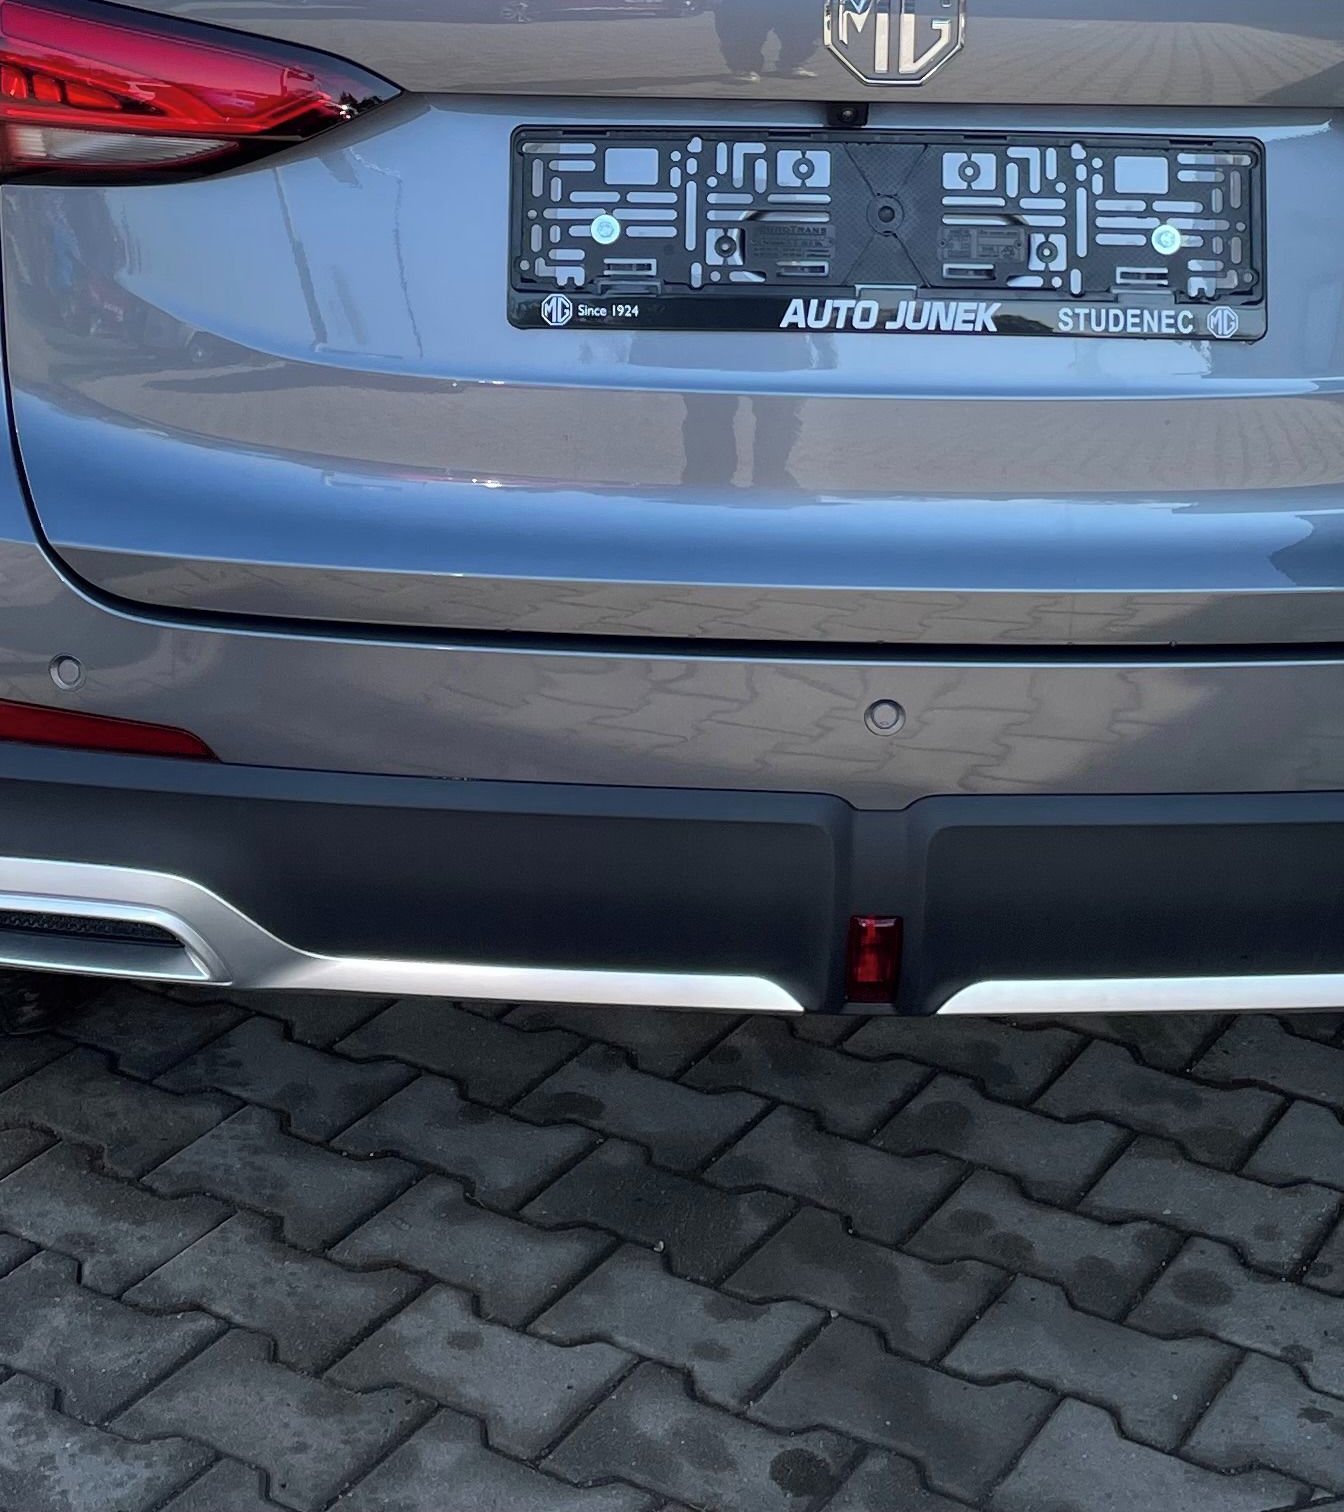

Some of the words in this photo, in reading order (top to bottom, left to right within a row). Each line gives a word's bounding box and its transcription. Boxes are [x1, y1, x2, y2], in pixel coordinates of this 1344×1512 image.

[544, 296, 570, 323] MG
[577, 303, 608, 317] Since
[612, 304, 639, 318] 1924
[779, 298, 880, 330] AUTO
[884, 300, 1002, 332] JUNEK
[1058, 307, 1194, 334] STUDENEC
[1210, 309, 1235, 335] MG
